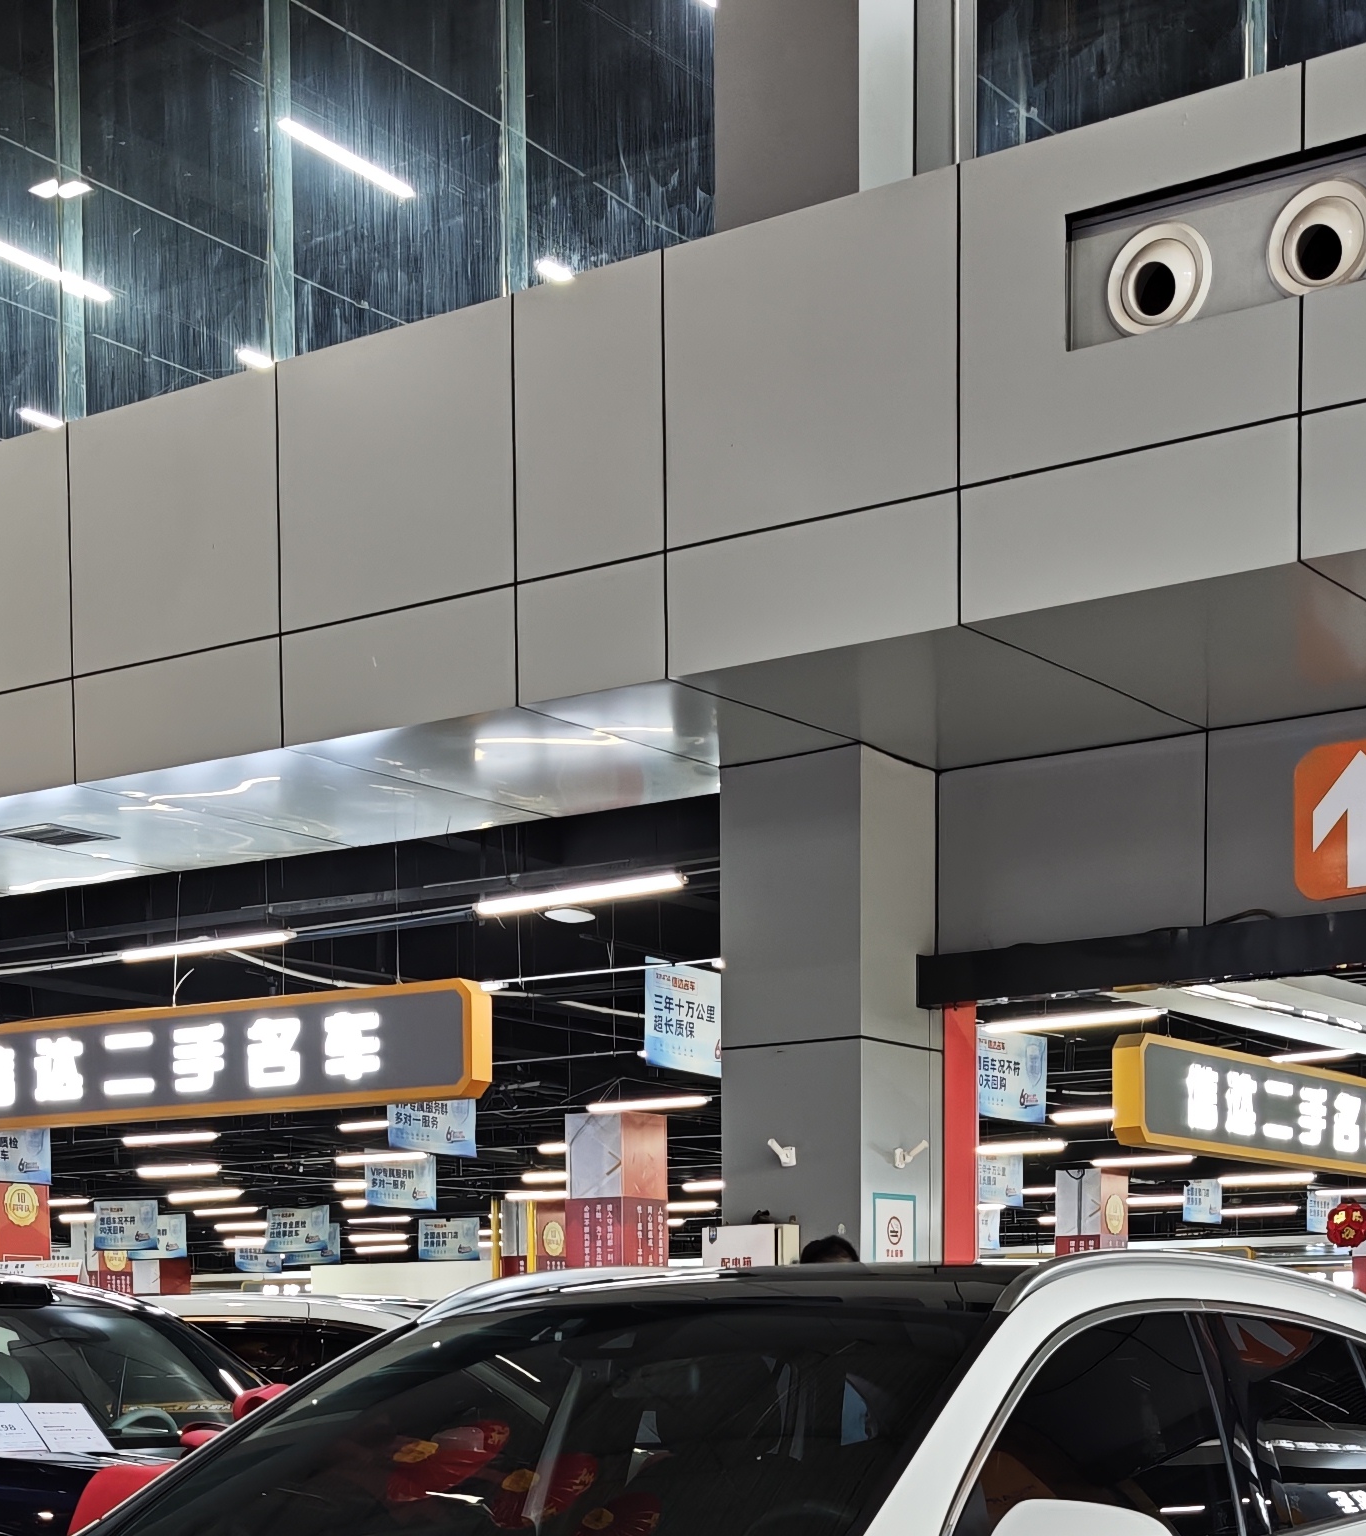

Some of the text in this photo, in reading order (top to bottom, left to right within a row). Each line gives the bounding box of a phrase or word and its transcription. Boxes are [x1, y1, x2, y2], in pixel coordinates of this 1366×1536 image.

[653, 993, 716, 1024] 三年十万公里
[653, 1015, 696, 1040] 超长质保
[978, 1073, 1007, 1091] 0天回购
[394, 1112, 439, 1129] 多对一服务
